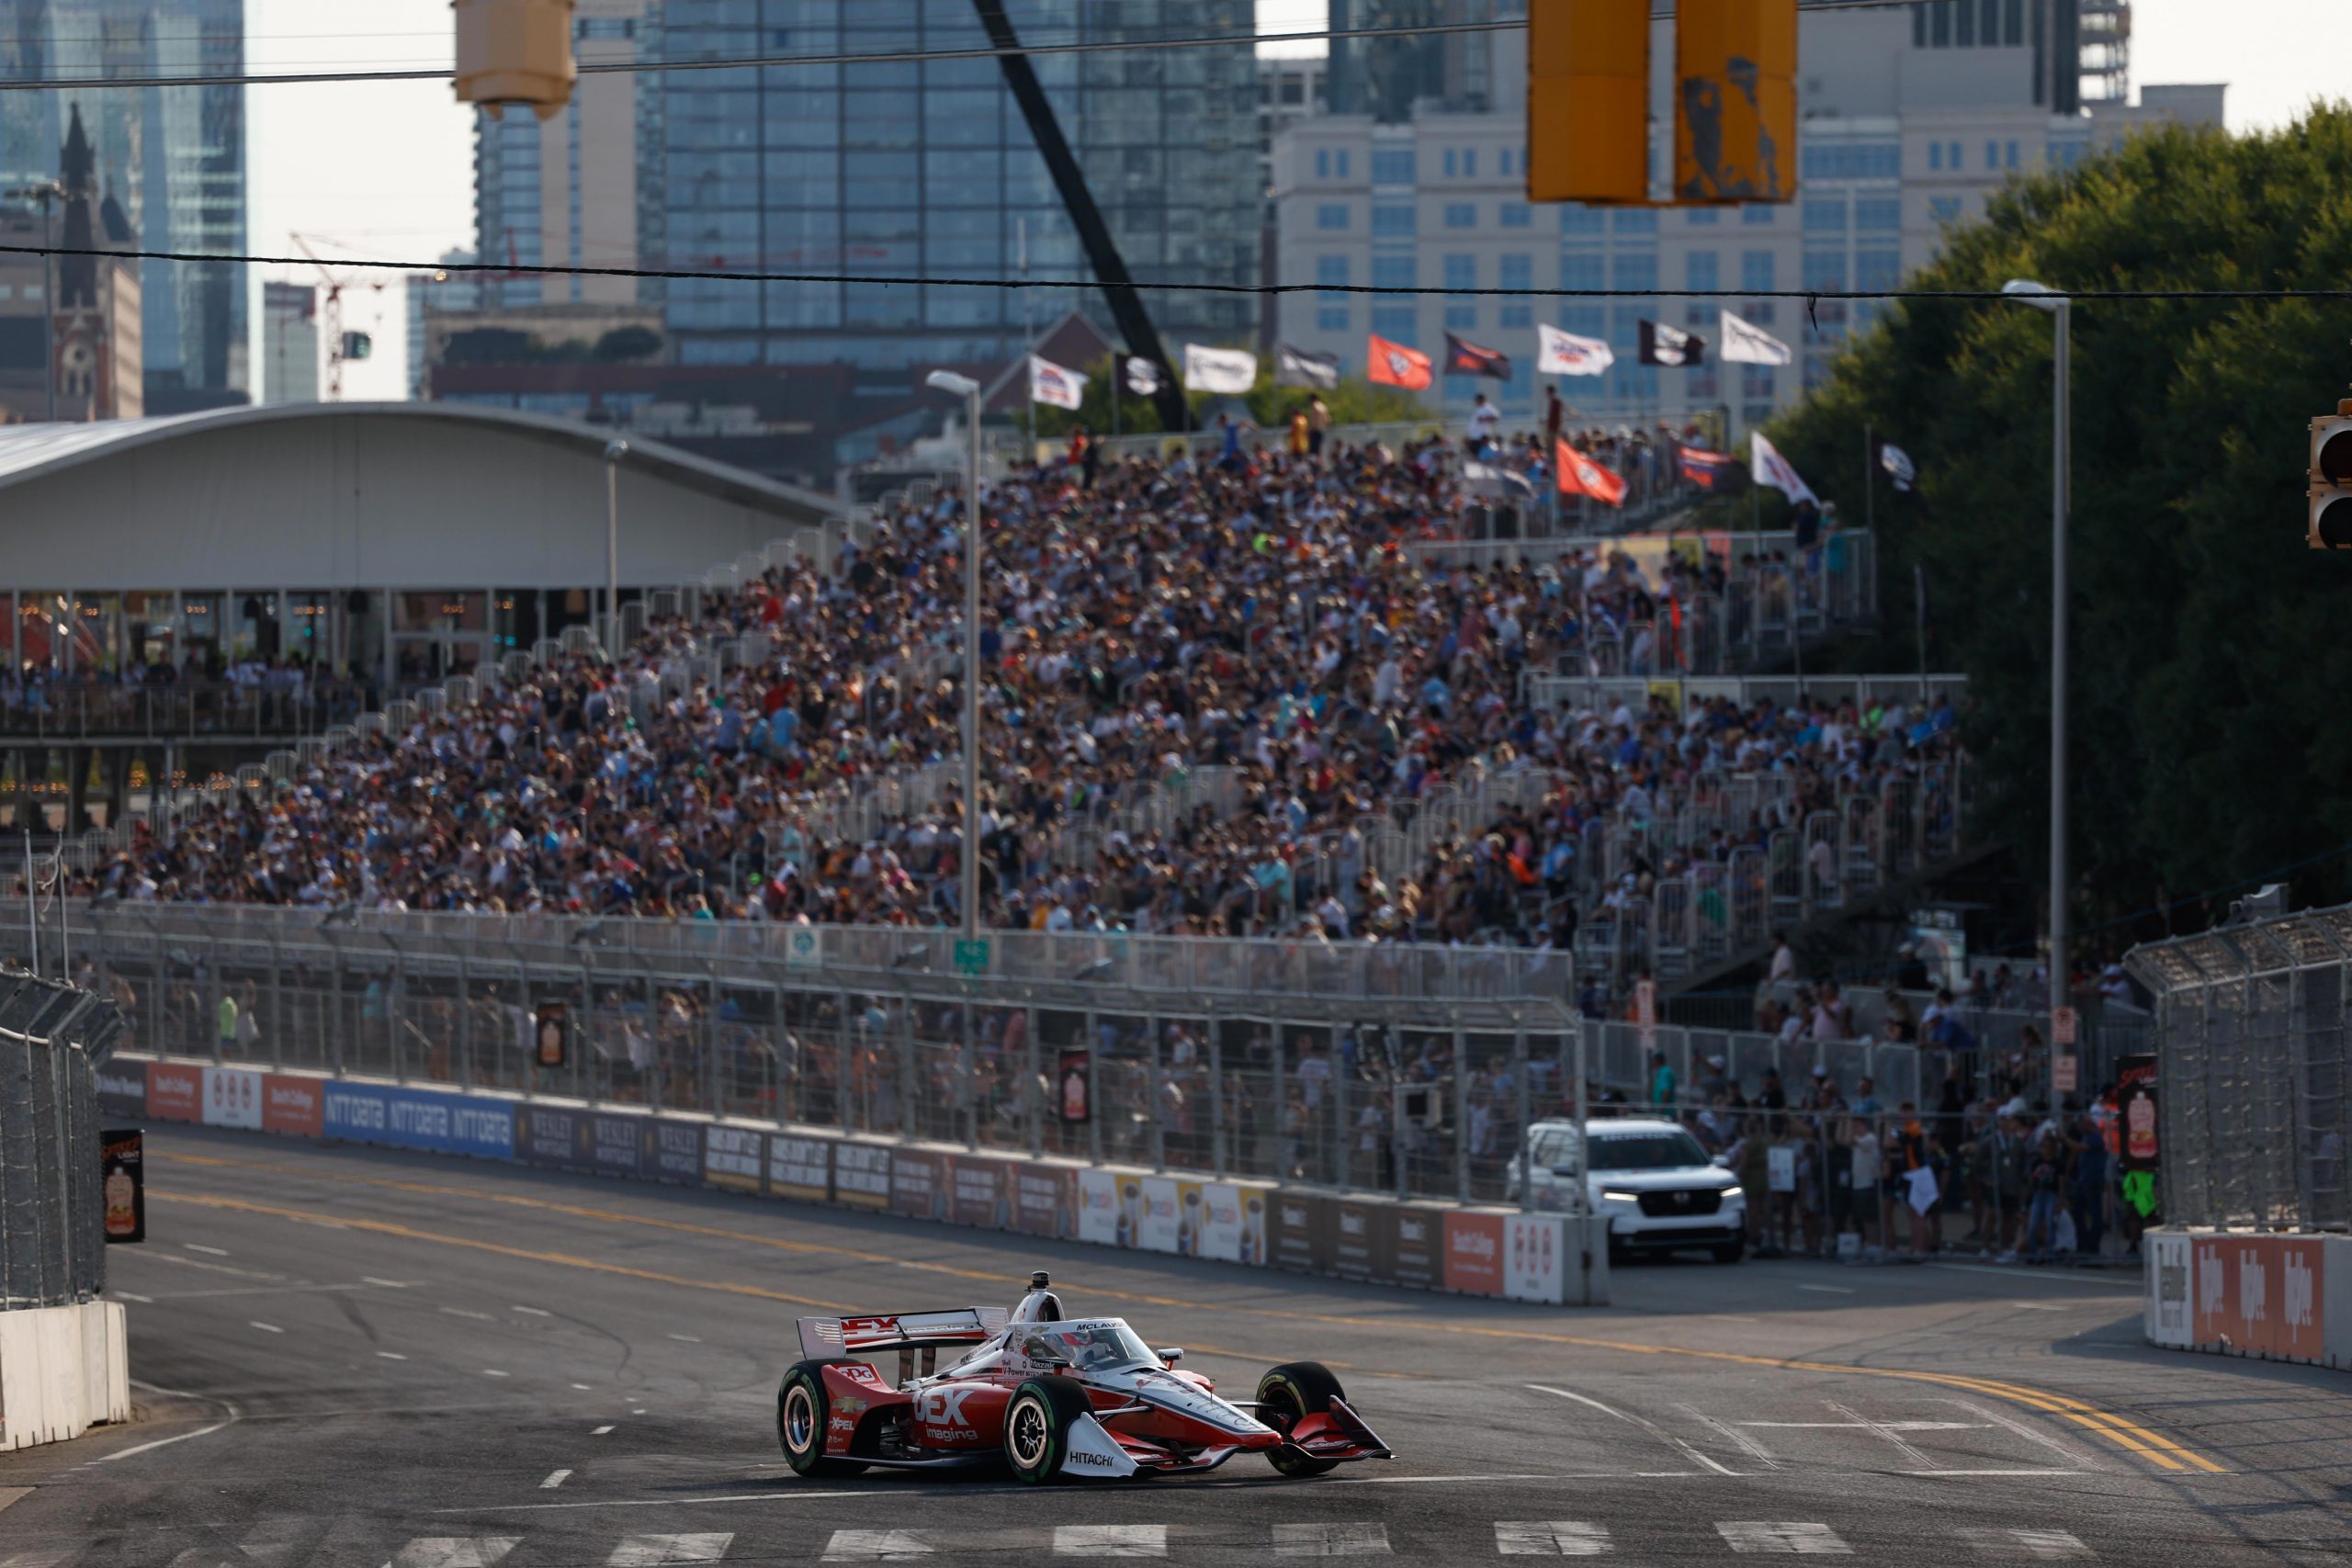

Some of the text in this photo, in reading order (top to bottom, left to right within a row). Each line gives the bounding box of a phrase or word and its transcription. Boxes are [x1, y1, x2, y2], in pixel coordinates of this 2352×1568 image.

[1002, 1367, 1026, 1376] V-Power
[1030, 1360, 1056, 1369] Mazak
[912, 1388, 974, 1426] DEX
[831, 1416, 854, 1431] XPEL
[926, 1424, 978, 1442] imaging
[1069, 1451, 1114, 1467] HITACHI
